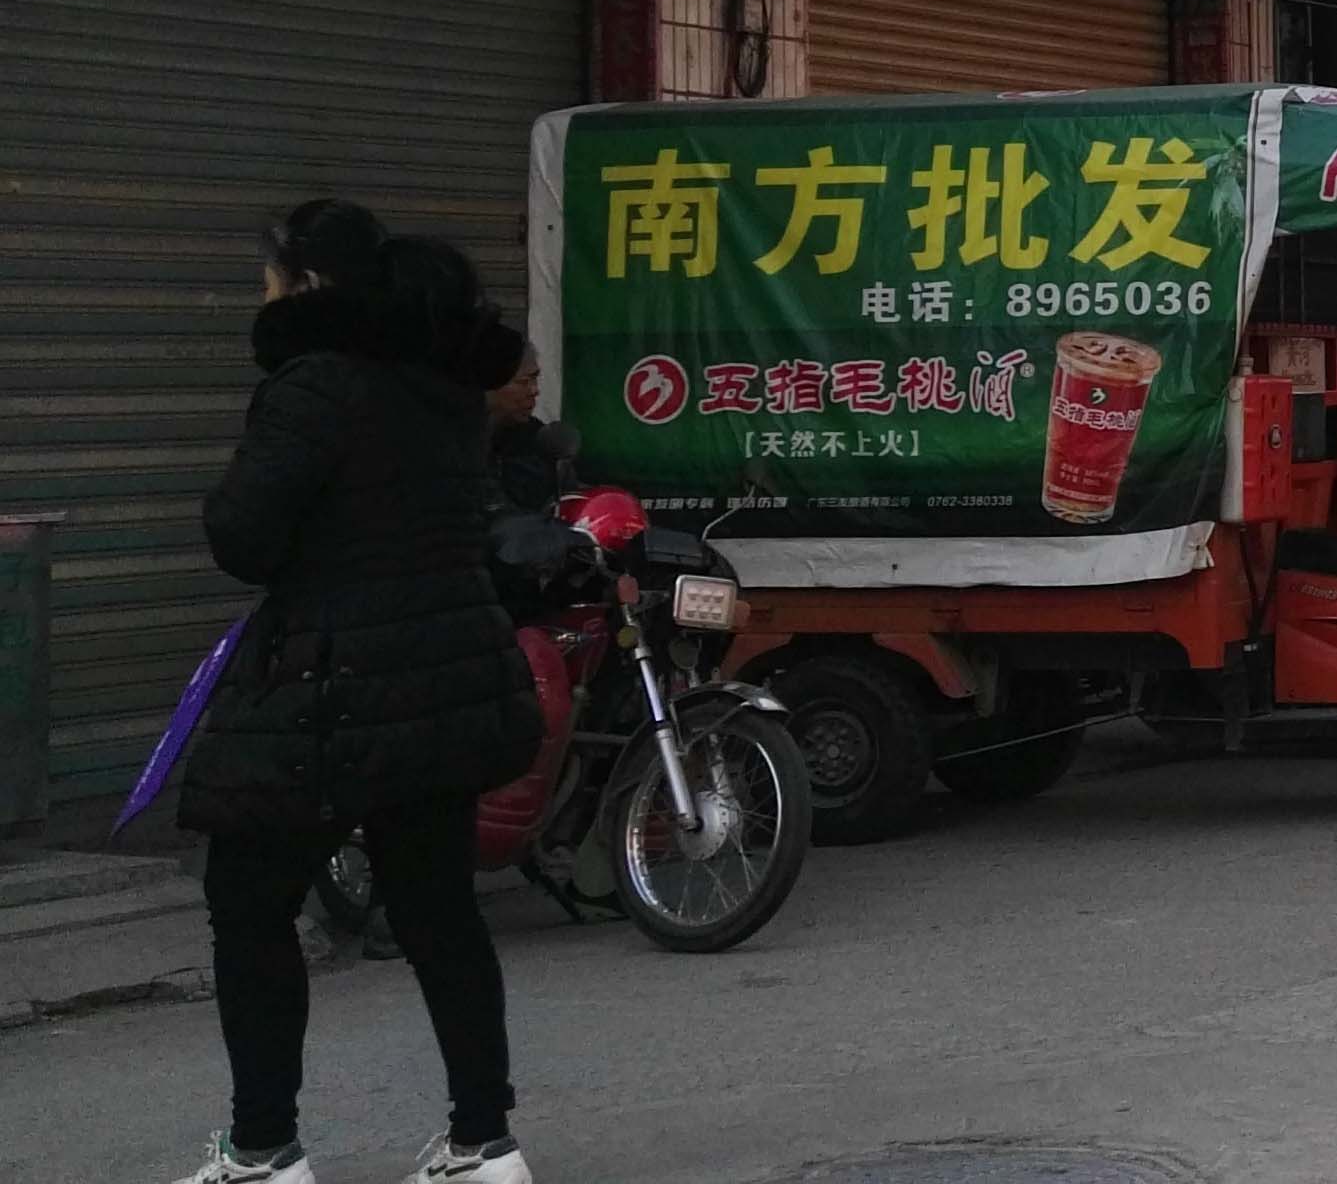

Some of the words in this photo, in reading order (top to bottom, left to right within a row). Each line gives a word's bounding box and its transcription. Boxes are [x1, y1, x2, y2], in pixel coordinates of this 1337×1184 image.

[601, 137, 1212, 279] 南方批发
[698, 349, 1028, 422] 五指毛桃酒
